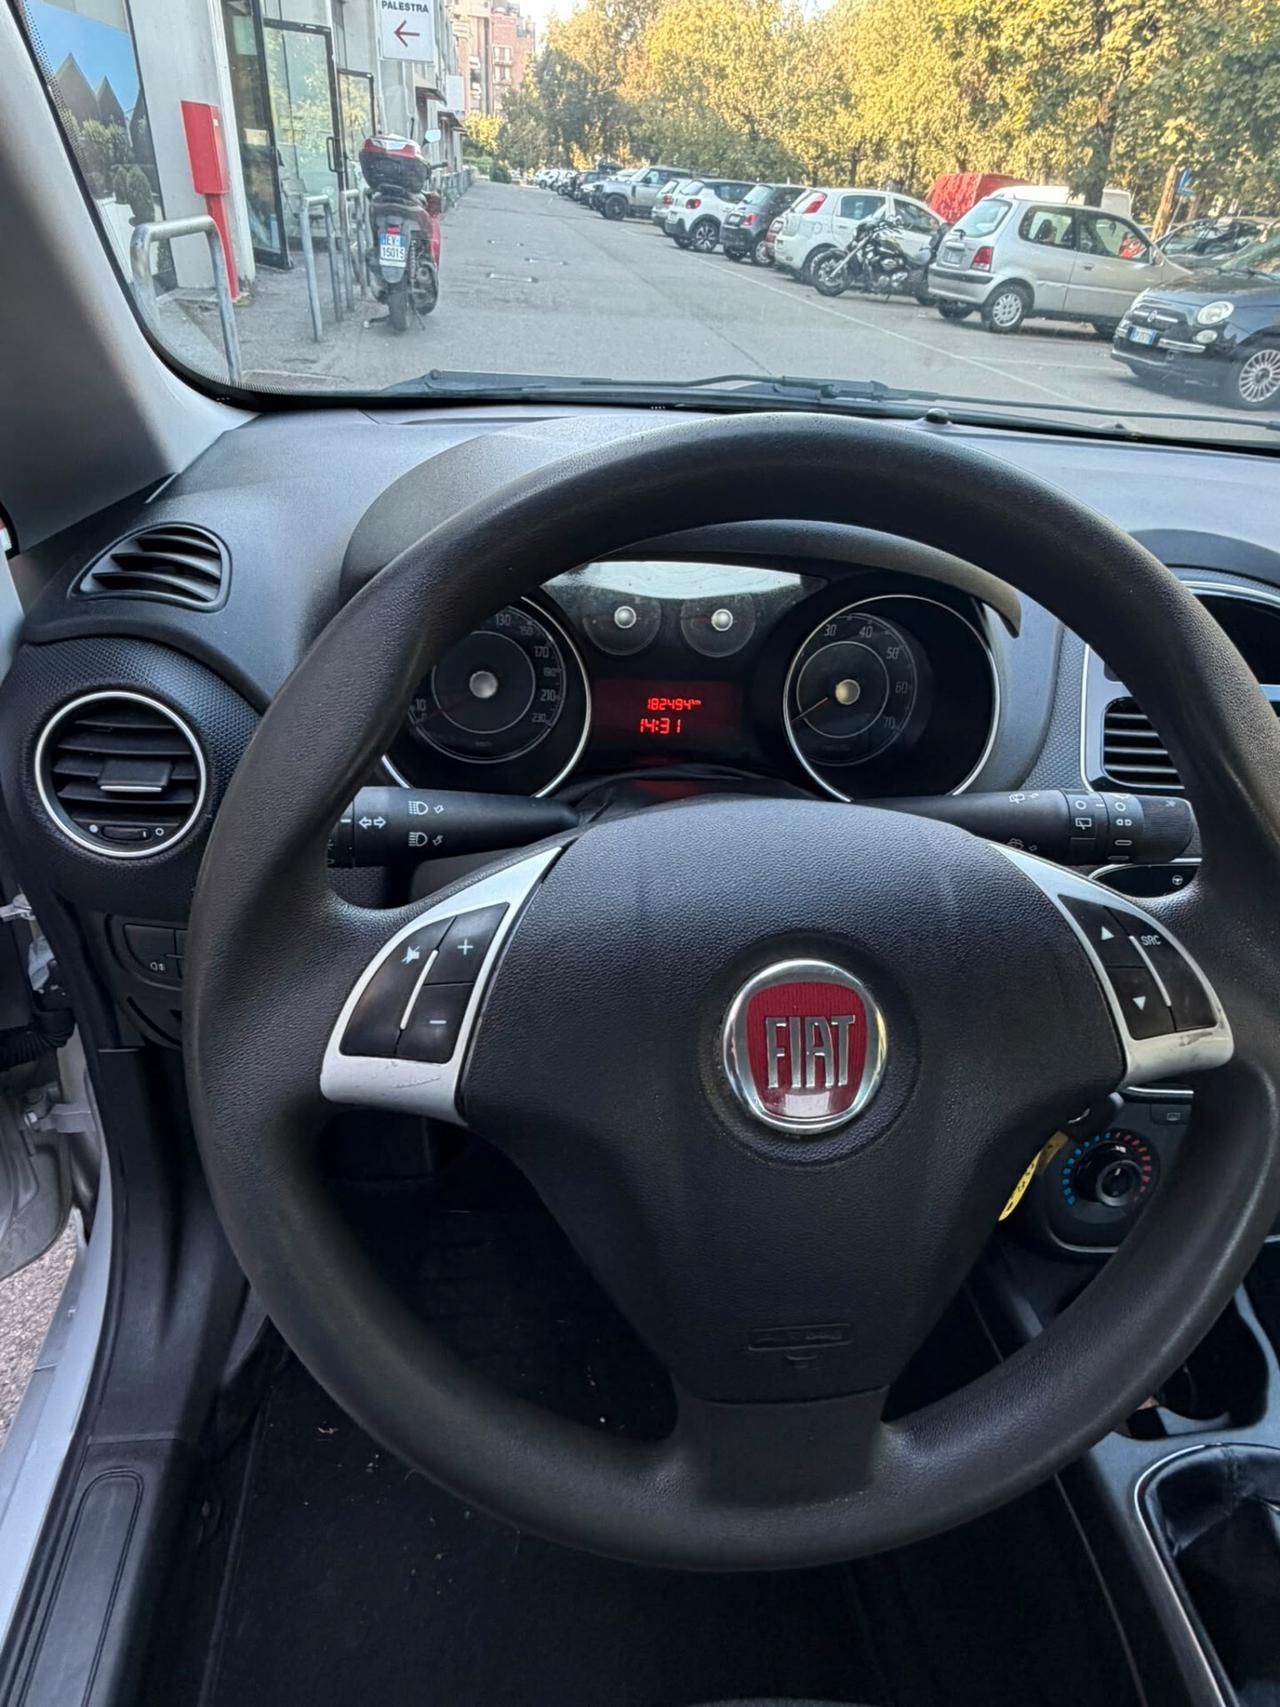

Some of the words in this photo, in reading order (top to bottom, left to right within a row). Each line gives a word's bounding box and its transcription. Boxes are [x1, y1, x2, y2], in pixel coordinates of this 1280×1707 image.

[381, 0, 429, 13] PALESTRA
[495, 613, 512, 627] 130
[823, 623, 837, 637] 30
[858, 625, 873, 639] 40
[533, 645, 550, 659] 170
[885, 646, 899, 660] 50
[894, 680, 908, 694] 60
[540, 689, 557, 702] 210
[640, 717, 681, 734] 14:31
[883, 716, 897, 730] 70
[1140, 934, 1162, 946] SRC
[765, 1014, 856, 1089] FIAT
